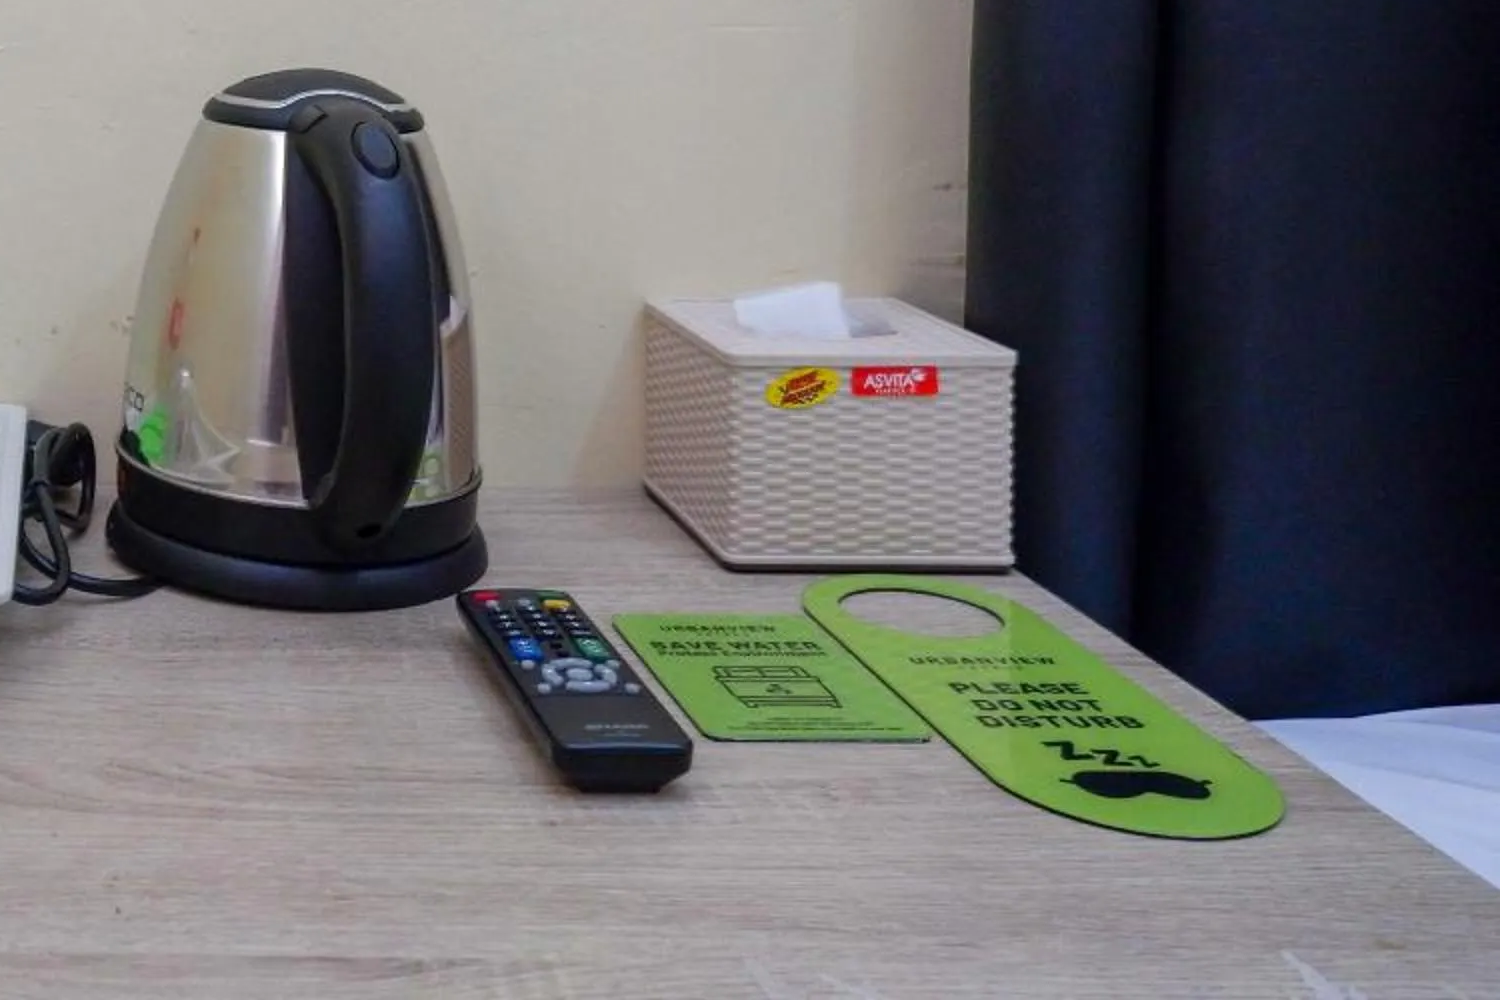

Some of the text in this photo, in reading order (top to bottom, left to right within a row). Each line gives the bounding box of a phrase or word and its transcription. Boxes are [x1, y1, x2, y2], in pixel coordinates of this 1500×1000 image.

[863, 373, 915, 390] ASVITA
[649, 640, 823, 651] SAVE WATER
[908, 655, 1056, 666] URBANVIEW
[947, 681, 1090, 696] PLEASE
[970, 699, 1104, 713] DO NOT
[974, 714, 1145, 729] DISTURB
